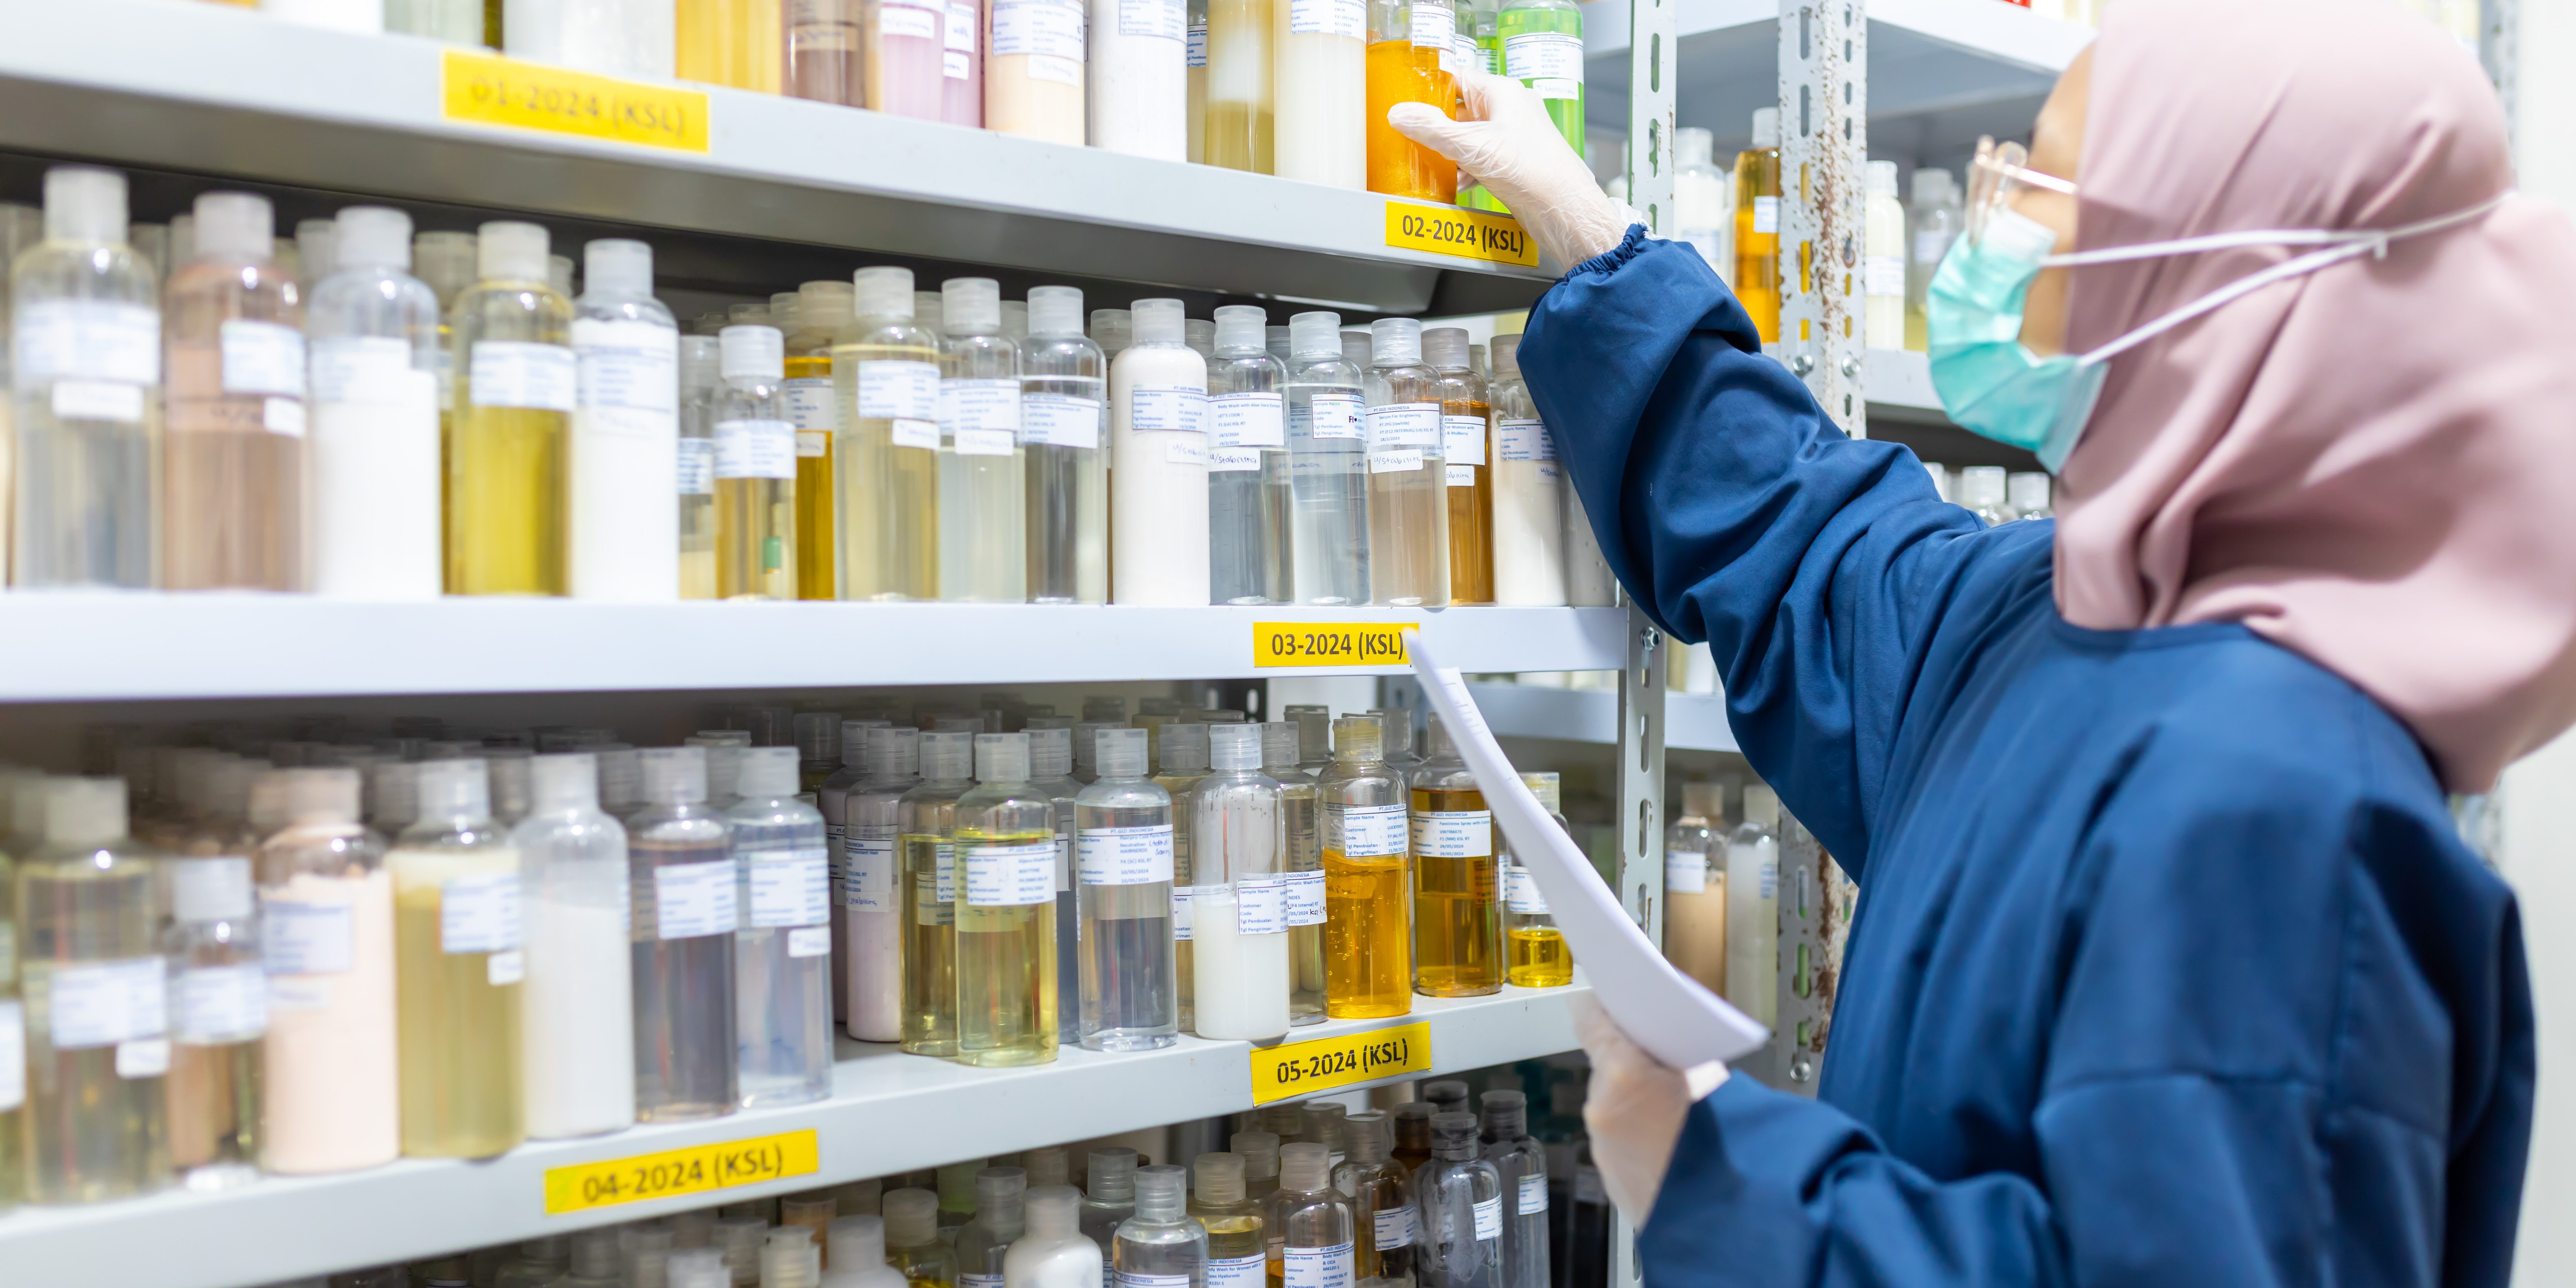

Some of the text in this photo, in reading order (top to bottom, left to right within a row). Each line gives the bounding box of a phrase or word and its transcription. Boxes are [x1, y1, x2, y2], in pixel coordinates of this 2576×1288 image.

[471, 76, 685, 138] 01-2024 (KSL)
[1403, 215, 1523, 258] 02-2024 (KSL)
[1272, 632, 1404, 660] 03-2024 (KSL)
[1277, 1038, 1408, 1084] 05-2024 (KSL)
[583, 1142, 783, 1203] 04-2024 (KSL)
